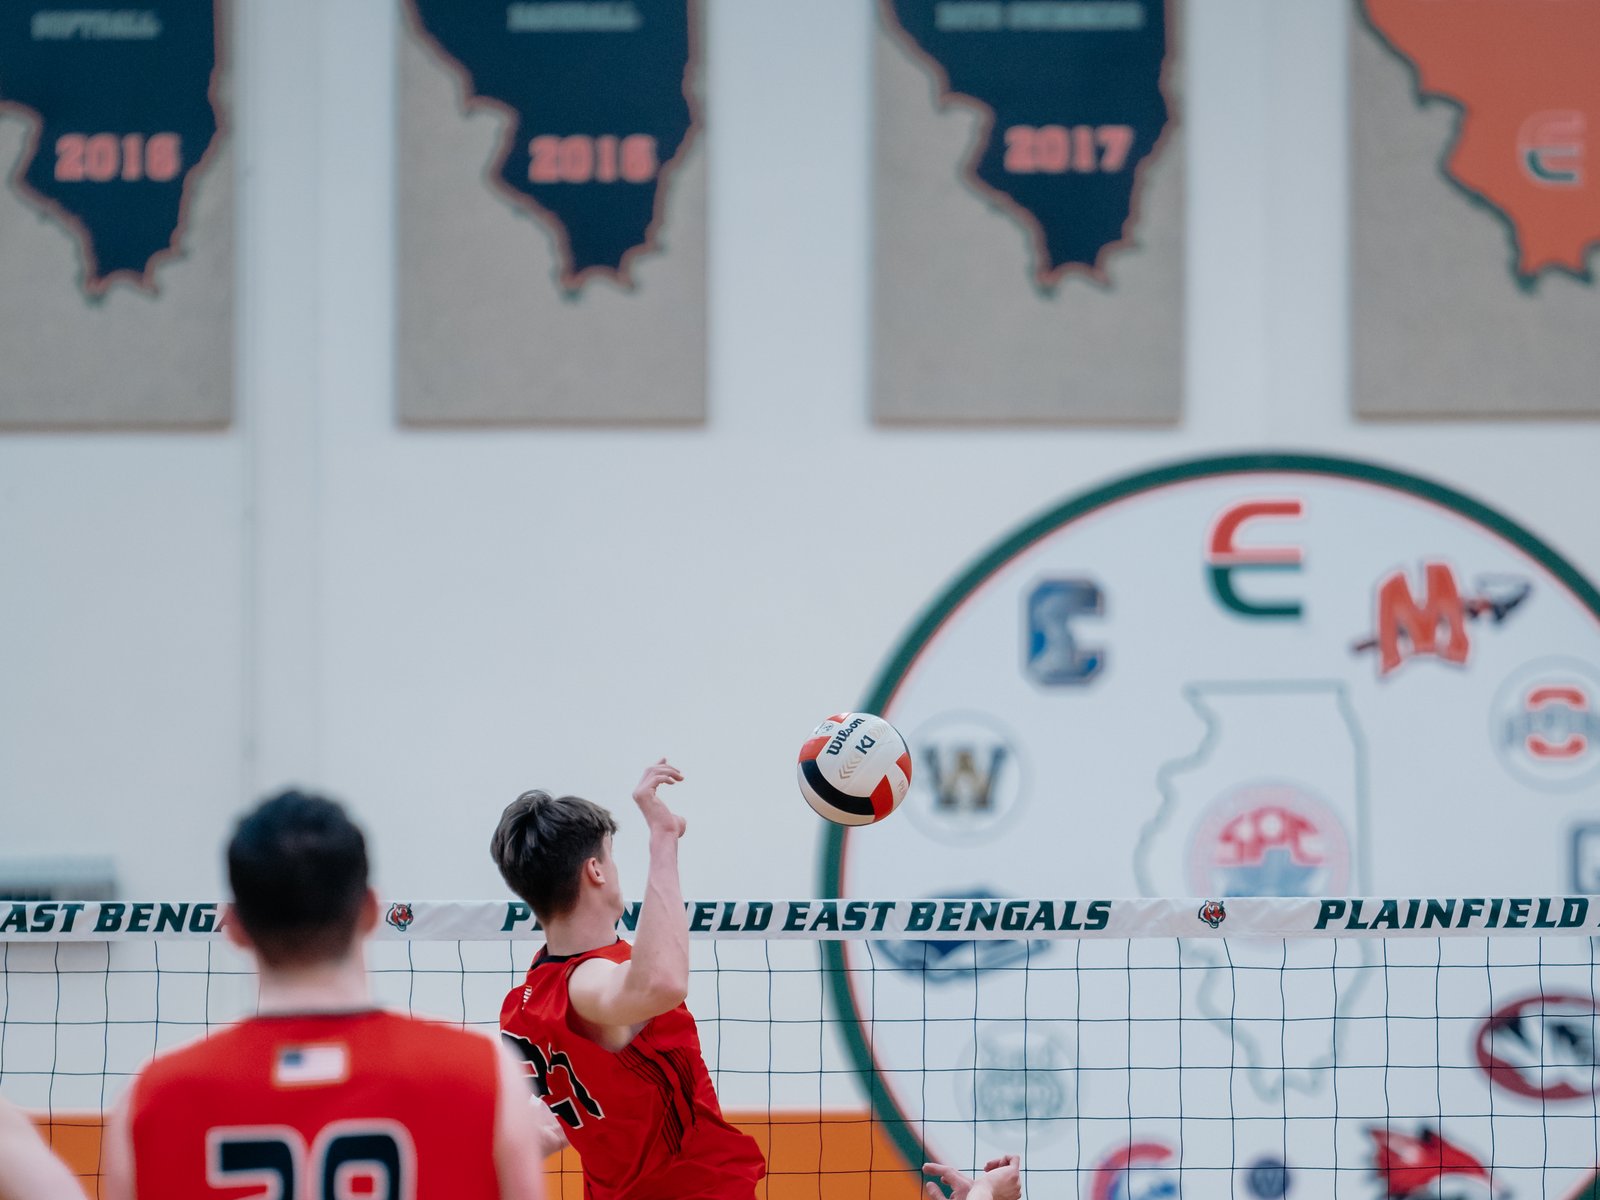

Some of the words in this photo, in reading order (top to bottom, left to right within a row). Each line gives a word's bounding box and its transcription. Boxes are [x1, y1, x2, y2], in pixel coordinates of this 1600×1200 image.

[1004, 124, 1134, 173] 2017
[826, 718, 866, 755] Wilson
[93, 903, 224, 932] BENG
[781, 901, 896, 931] EAST
[904, 901, 1112, 931] BENGALS
[1313, 898, 1589, 929] PLAINFIELD
